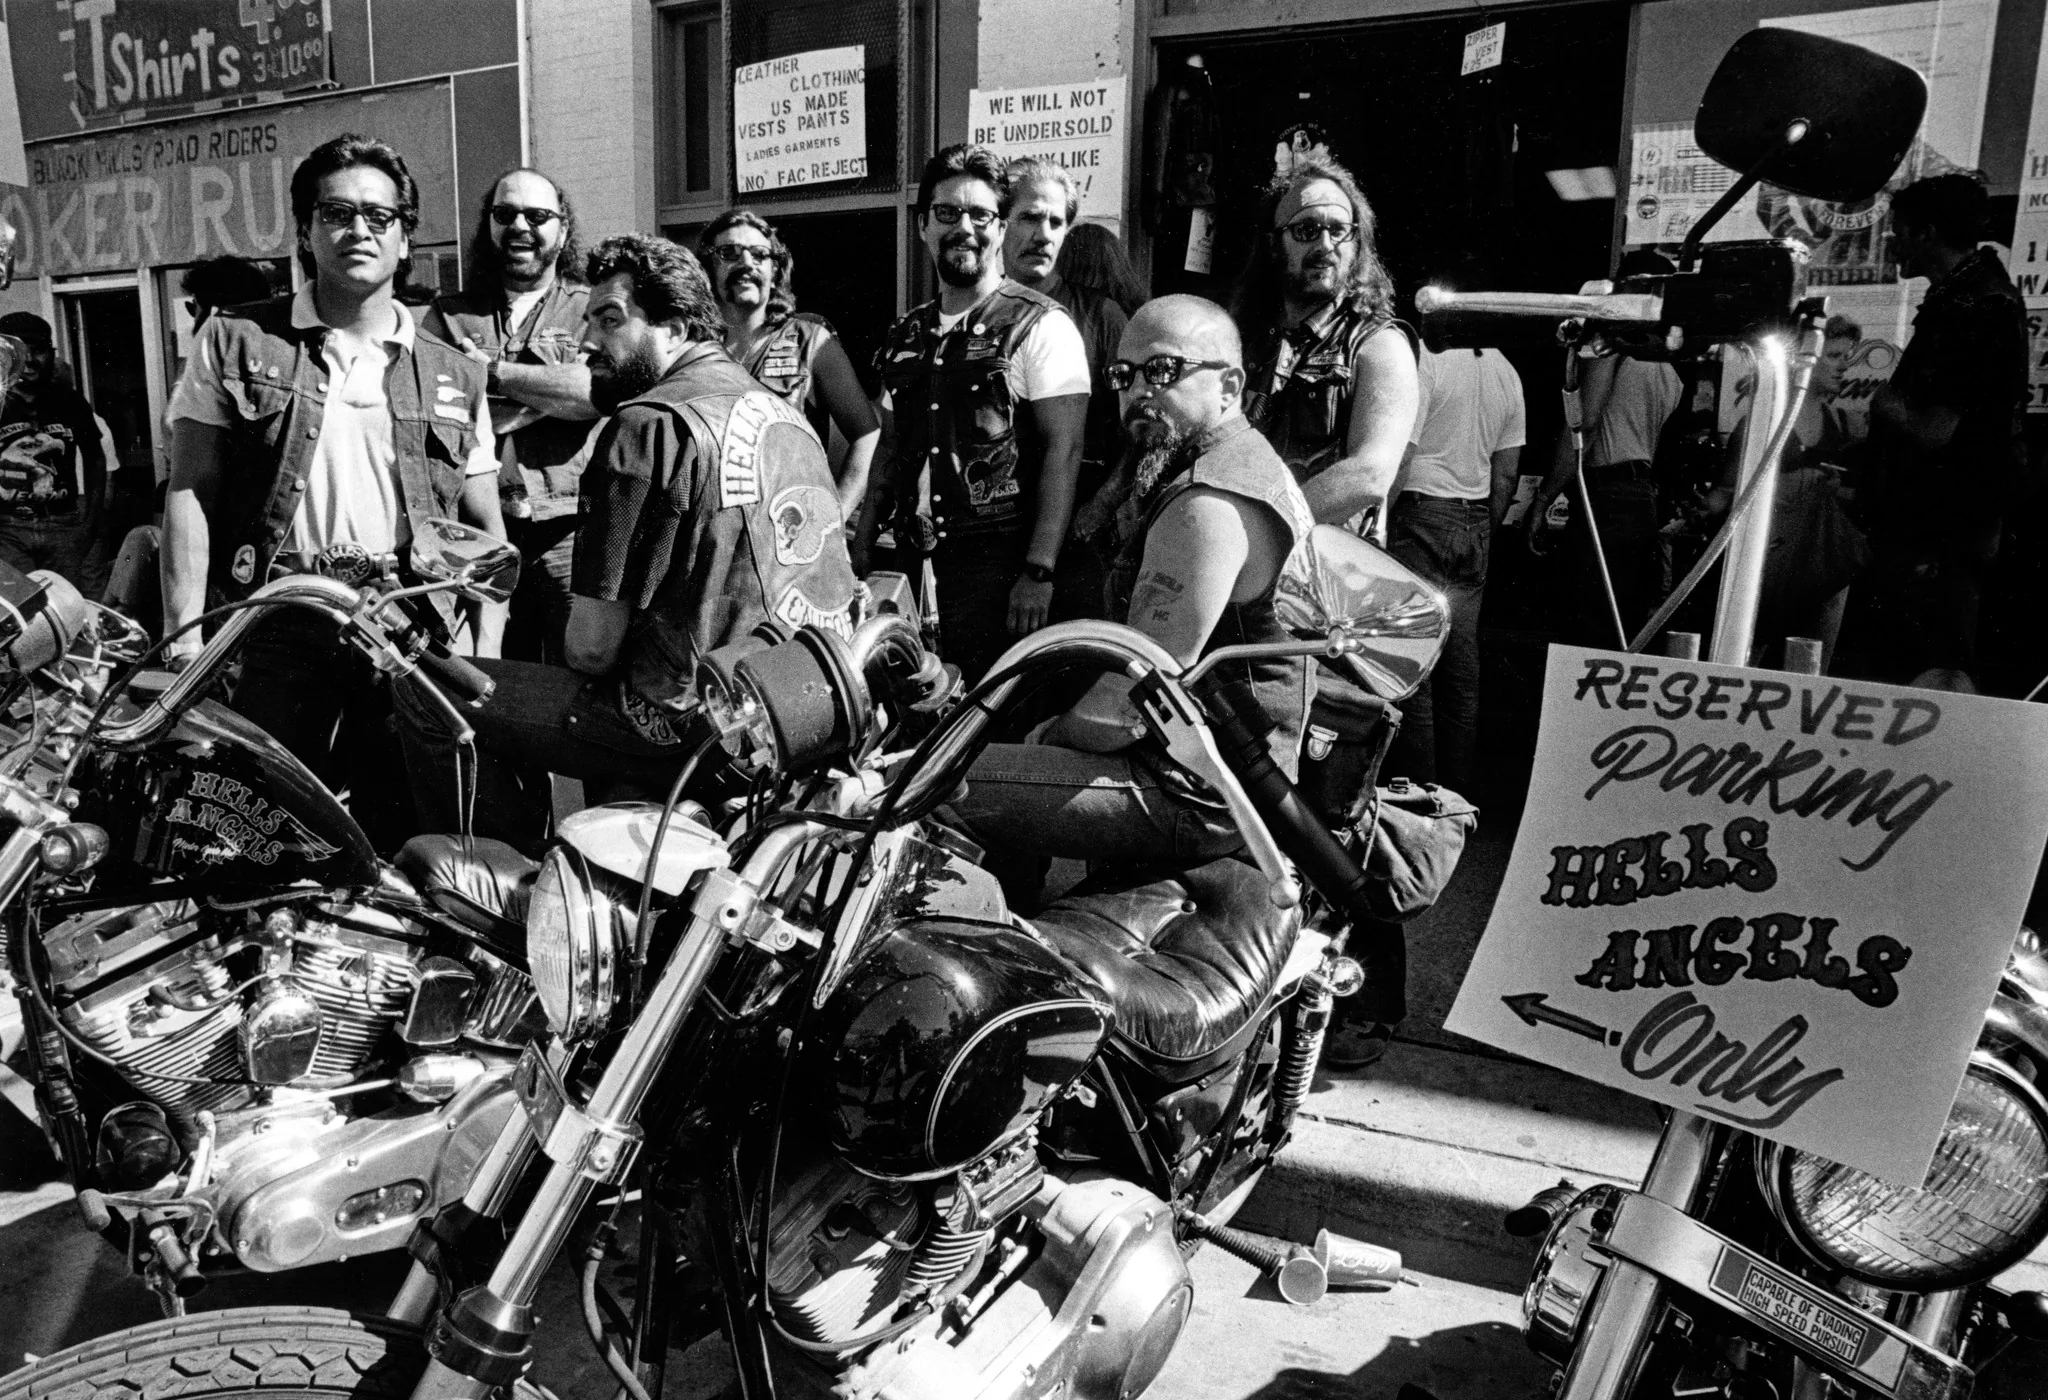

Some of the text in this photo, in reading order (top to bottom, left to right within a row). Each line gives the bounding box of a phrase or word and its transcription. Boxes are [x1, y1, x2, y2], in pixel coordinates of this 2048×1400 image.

[738, 57, 799, 85] LEATHER
[1475, 41, 1499, 59] VEST
[738, 109, 850, 140] VESTS PANTS
[771, 90, 848, 117] US MADE
[989, 88, 1107, 115] WE WILL NOT
[34, 123, 278, 185] BLACK HILLS ROAD RIDERS
[746, 136, 840, 162] LADIES GARMENTS
[975, 127, 996, 144] BE
[1060, 149, 1100, 168] LIKE
[778, 167, 806, 186] FAC
[811, 157, 867, 179] REJECT
[190, 155, 303, 255] RU
[725, 398, 769, 496] HELLS
[1574, 658, 1941, 746] RESERVED
[188, 771, 288, 835] HELLS
[1584, 724, 1954, 872] Parking
[166, 798, 285, 866] ANGELS
[1540, 816, 1778, 908] HELLS
[1574, 912, 1913, 1009] ANGELS
[1620, 991, 1845, 1130] Only
[1744, 1287, 1856, 1360] HIGH SPEED PURSUIT
[1750, 1273, 1861, 1344] CAPABLE OF EVADING
